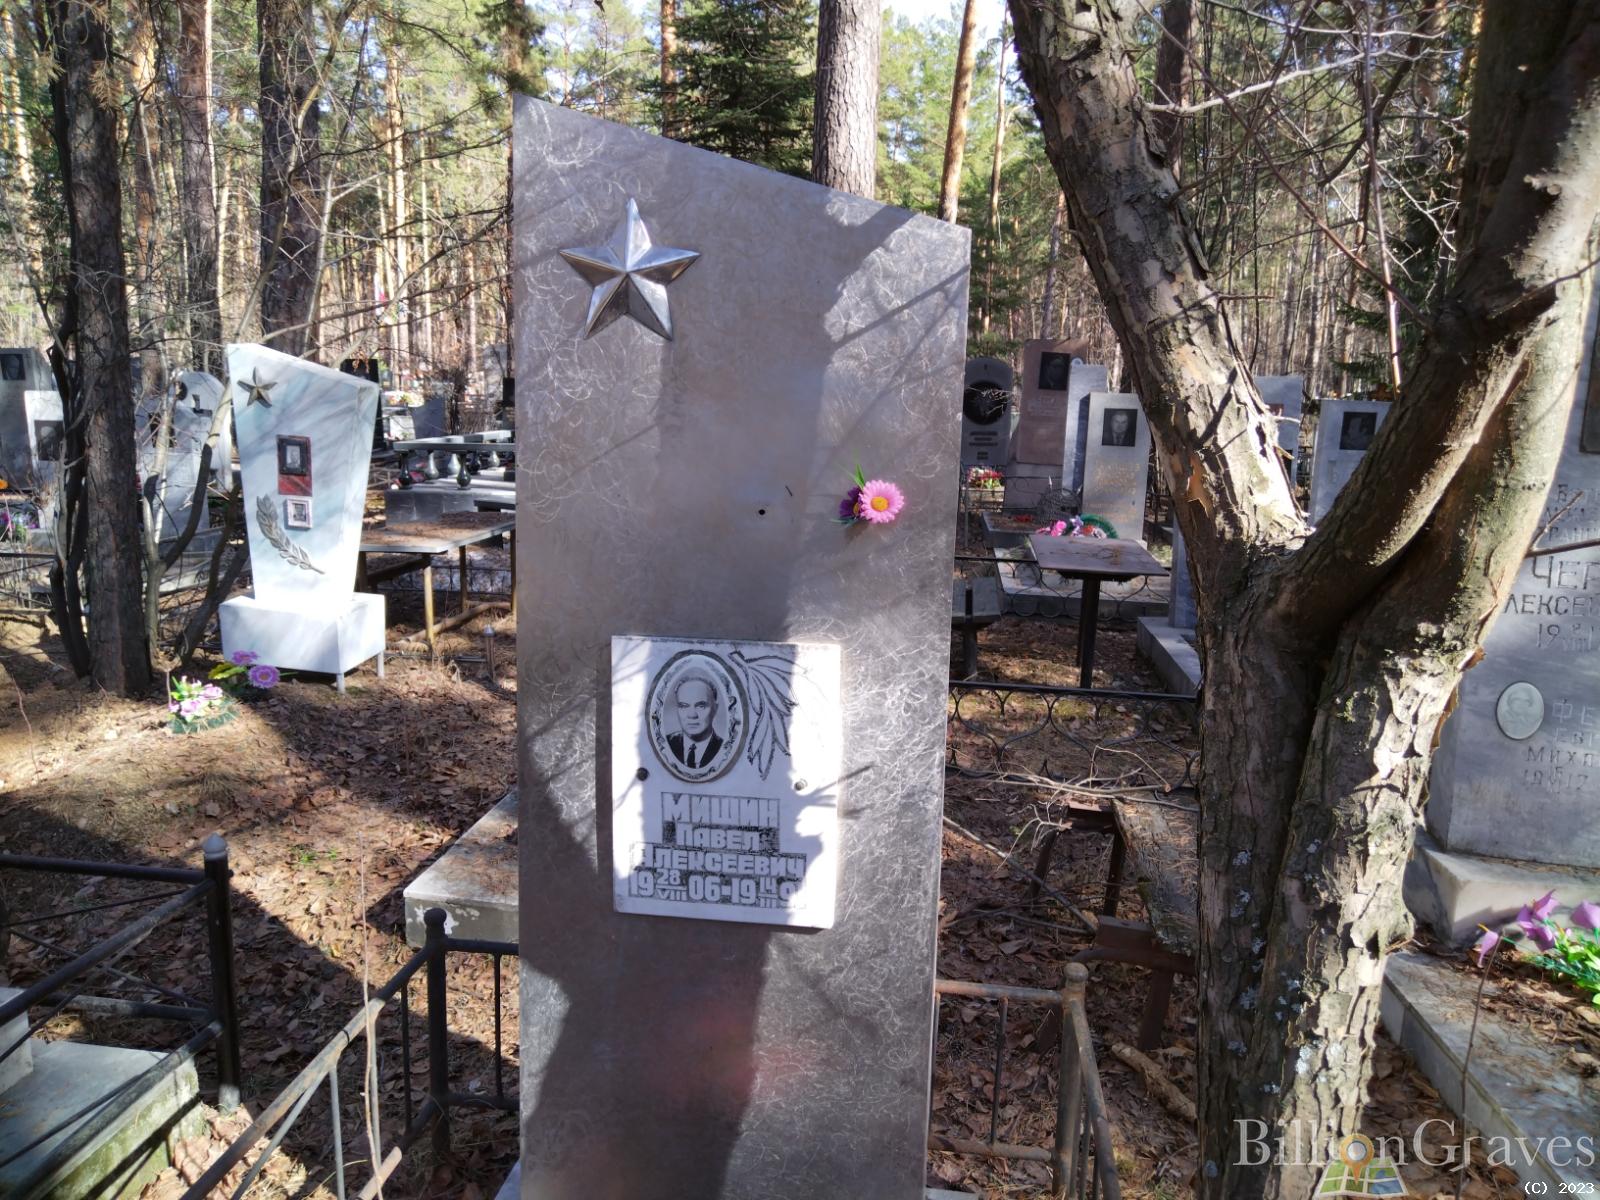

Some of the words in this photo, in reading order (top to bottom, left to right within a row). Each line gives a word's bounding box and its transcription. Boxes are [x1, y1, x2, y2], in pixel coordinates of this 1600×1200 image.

[1503, 593, 1600, 616] ЛЕКСЕ
[661, 792, 779, 830] МИШИН
[675, 822, 761, 850] ПАВЕЛ
